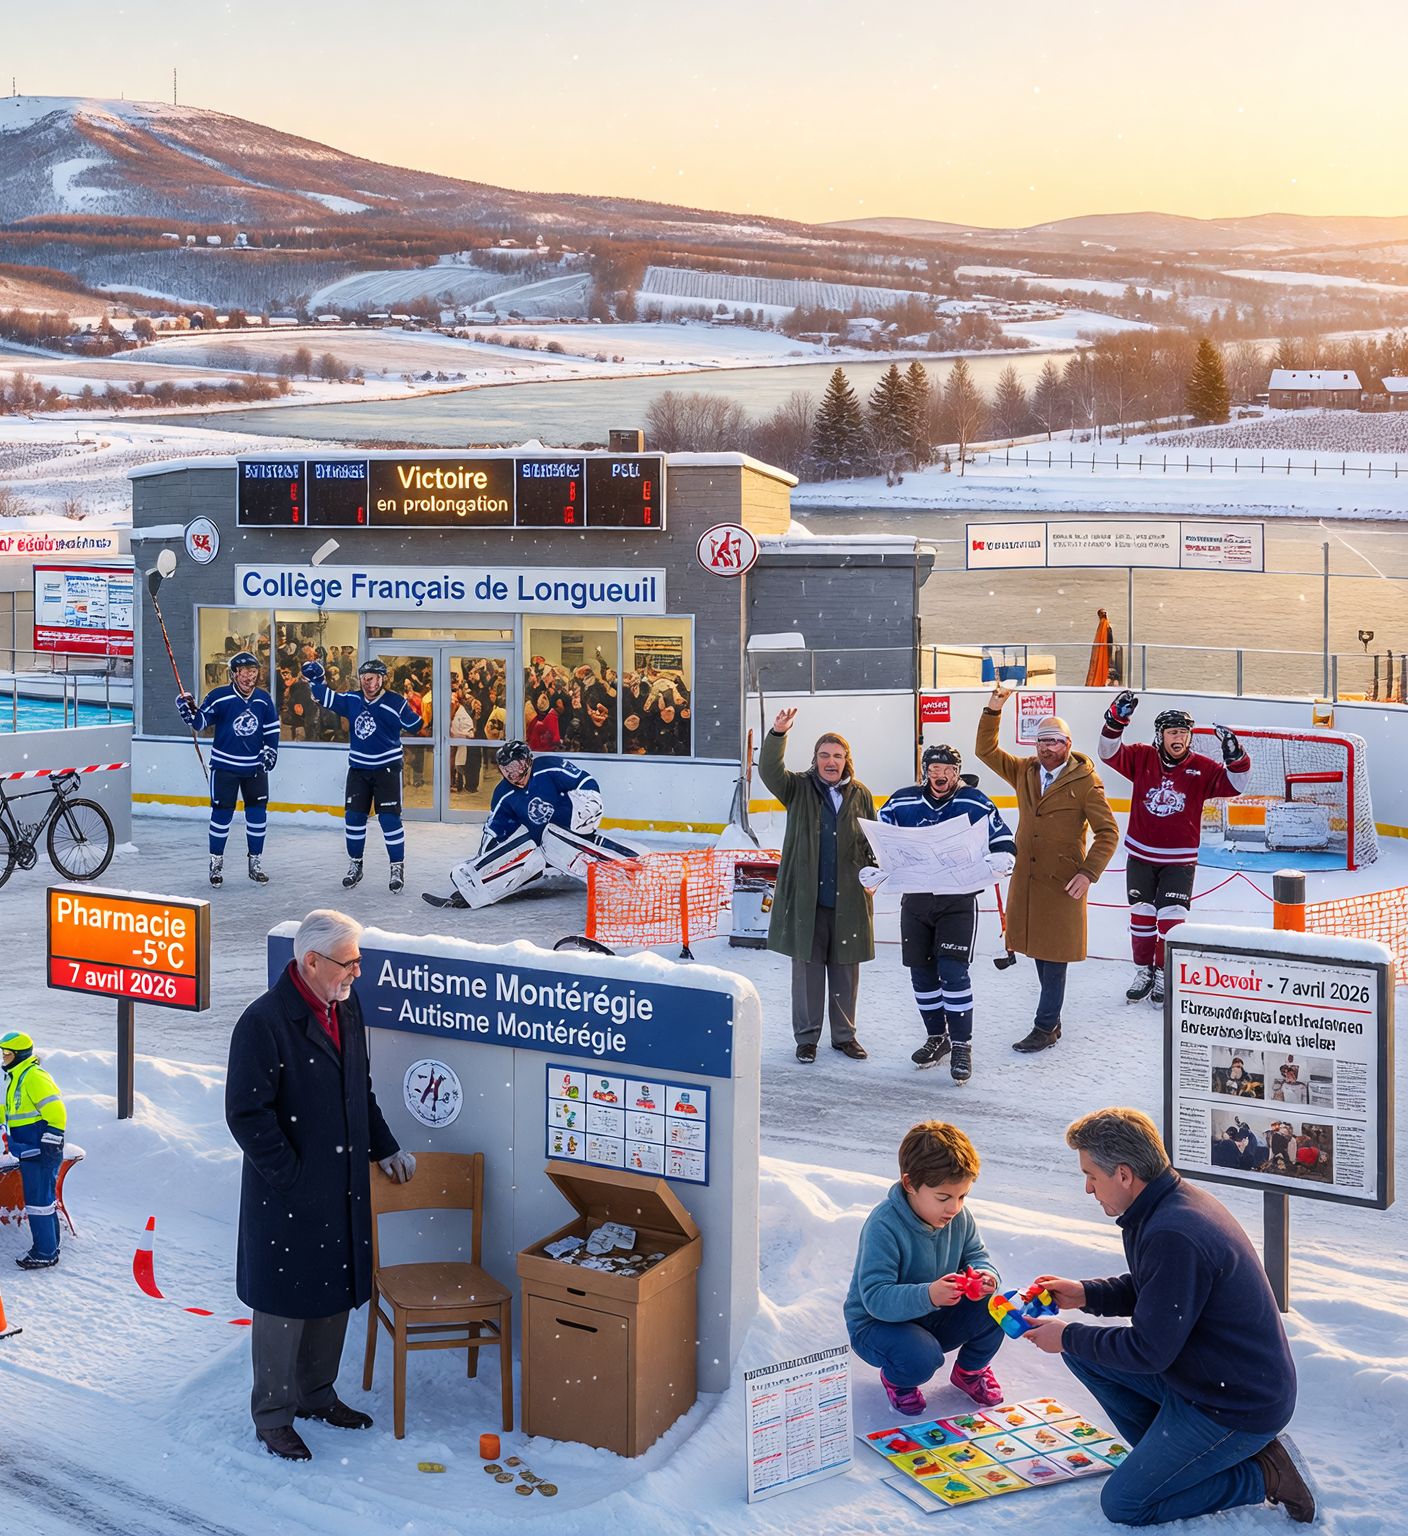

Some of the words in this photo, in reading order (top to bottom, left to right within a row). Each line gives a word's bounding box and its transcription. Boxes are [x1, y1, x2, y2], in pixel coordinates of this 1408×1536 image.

[397, 465, 487, 489] Victoire
[377, 498, 396, 512] en
[403, 495, 508, 516] prolongation
[242, 571, 342, 606] Collège
[351, 573, 466, 607] Français
[474, 574, 508, 600] de
[518, 575, 656, 609] Longueuil
[57, 898, 186, 939] Pharmacie
[132, 939, 185, 969] -5°C
[68, 963, 81, 984] 7
[85, 968, 124, 991] avril
[130, 972, 177, 998] 2026
[377, 959, 487, 998] Autisme
[495, 973, 653, 1025] Montérégie
[1180, 963, 1201, 985] Le
[1204, 966, 1263, 992] Devoir
[1279, 977, 1289, 994] 7
[1292, 981, 1325, 999] avril
[1330, 982, 1370, 1003] 2026
[398, 999, 489, 1034] Autisme
[496, 1012, 627, 1055] Montérégie
